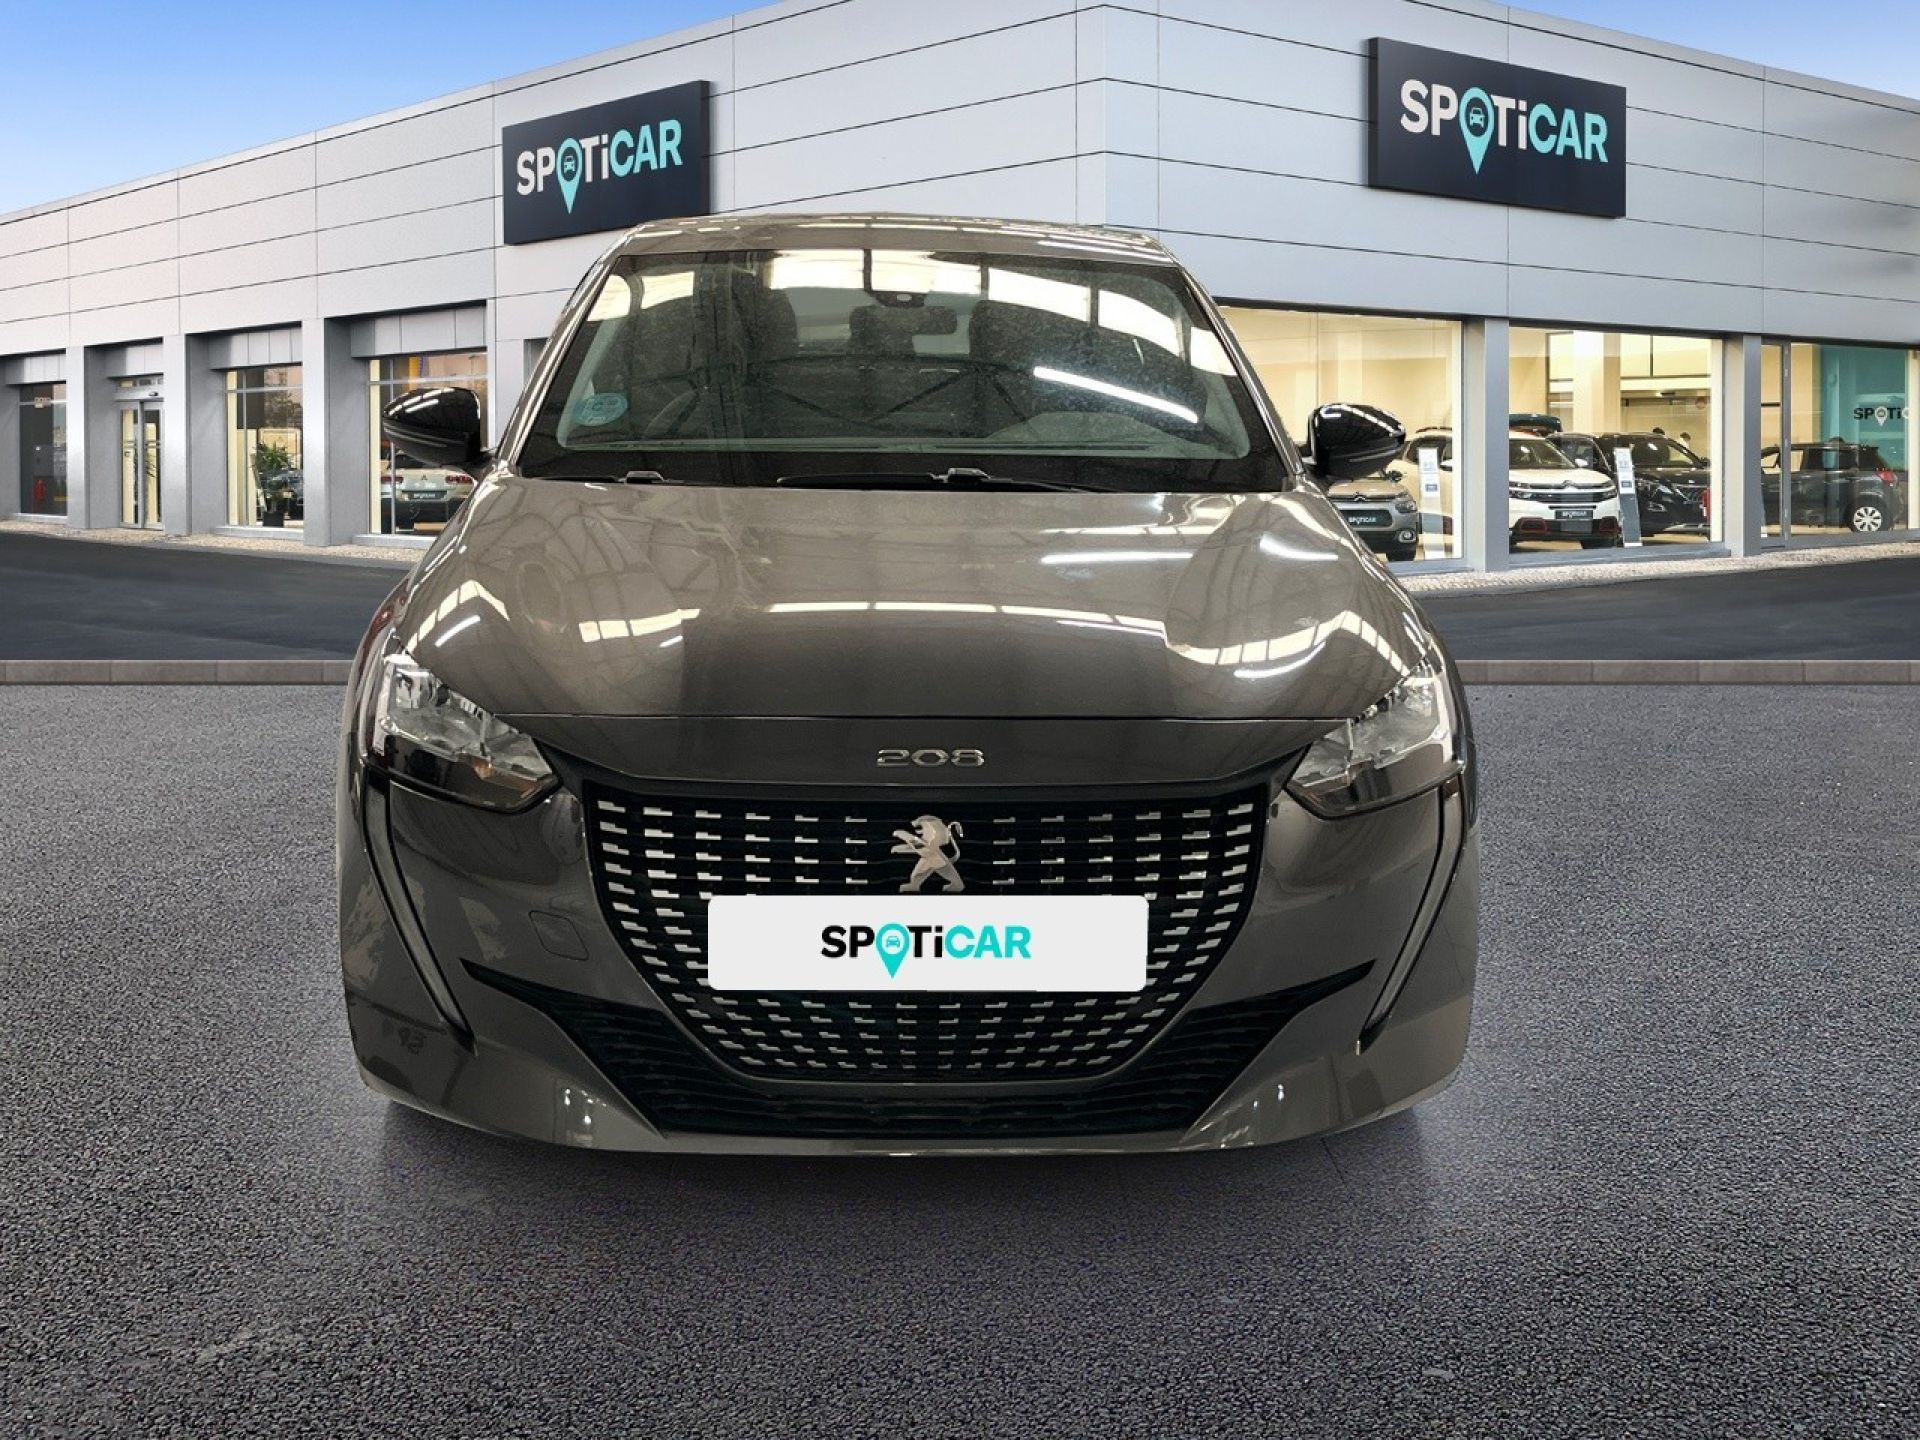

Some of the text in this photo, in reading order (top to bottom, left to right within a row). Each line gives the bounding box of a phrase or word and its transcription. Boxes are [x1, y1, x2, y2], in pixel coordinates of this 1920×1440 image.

[516, 119, 683, 214] SPOTiCAR
[1400, 79, 1609, 175] SPOTiCAR
[876, 749, 985, 767] 208
